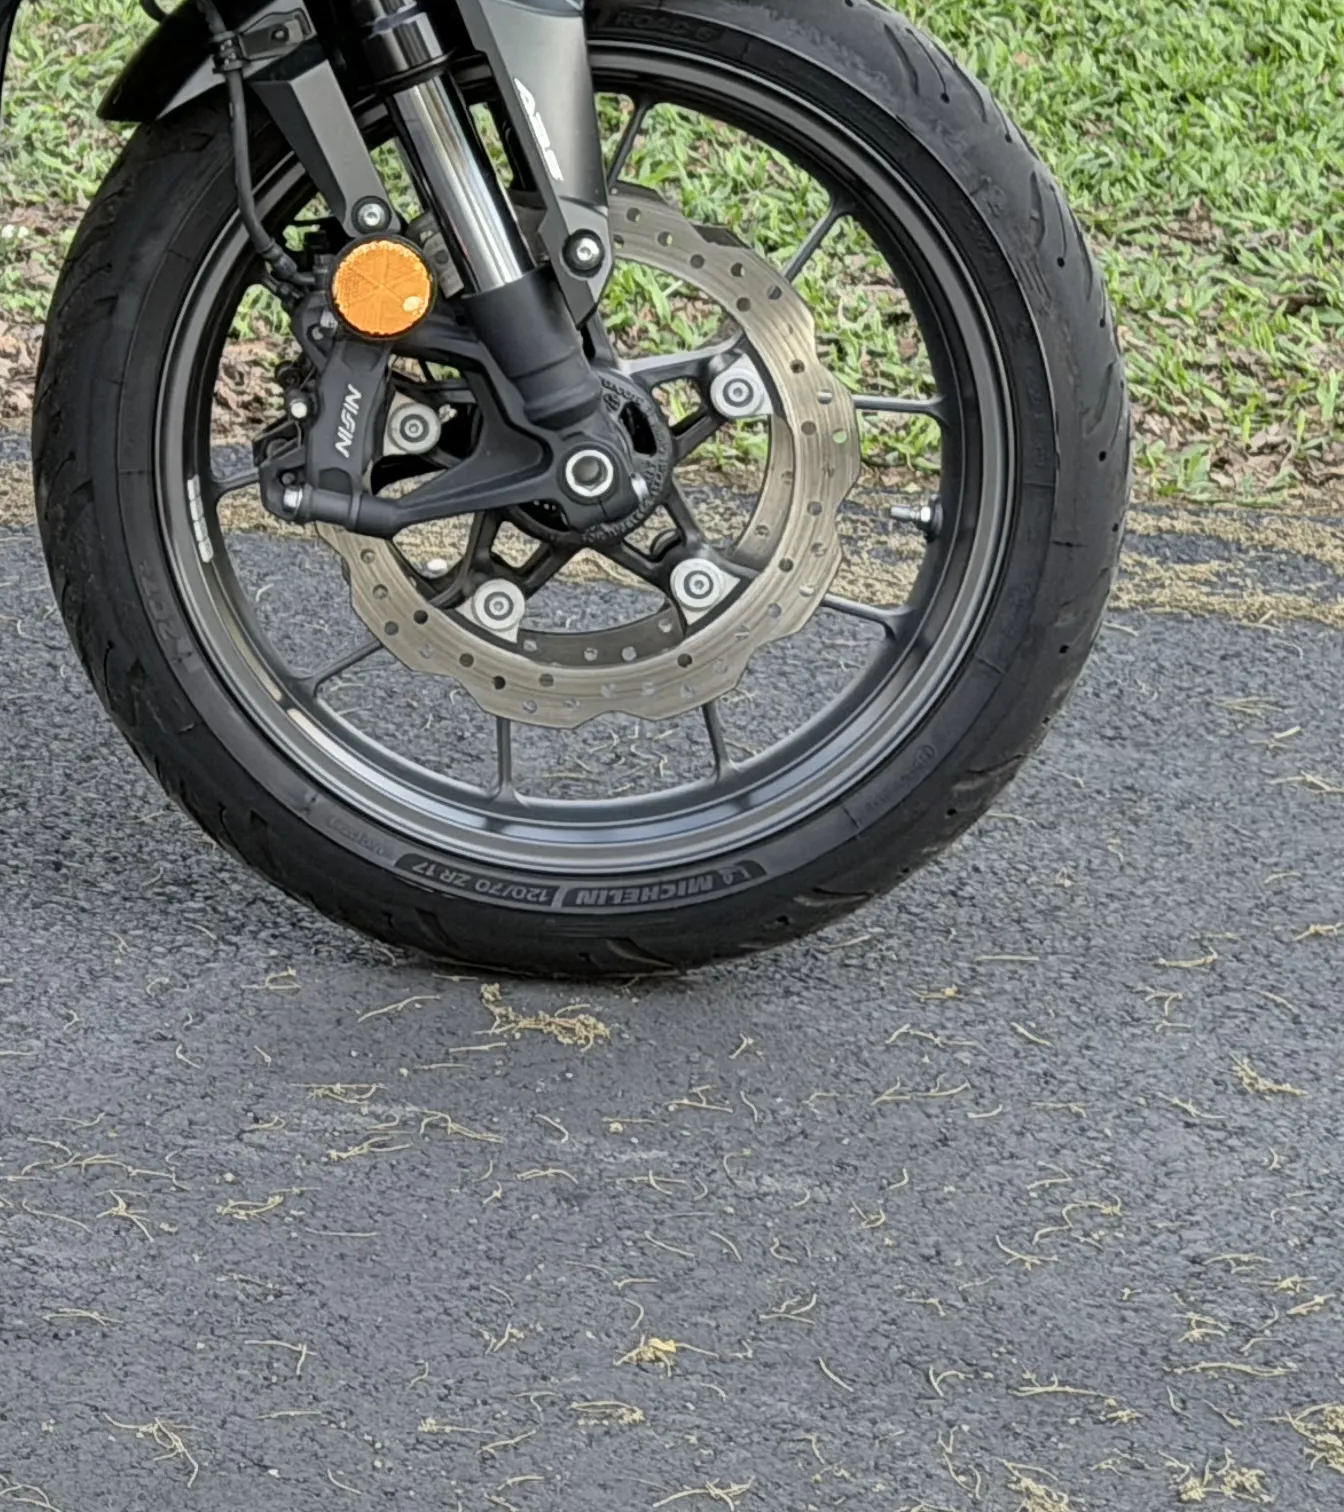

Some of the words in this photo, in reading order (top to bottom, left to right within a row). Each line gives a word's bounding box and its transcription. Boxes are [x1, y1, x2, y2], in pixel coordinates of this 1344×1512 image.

[412, 860, 437, 876] 17
[439, 870, 472, 888] ZR
[575, 874, 713, 905] MICHELIN
[474, 878, 551, 903] 120/70
